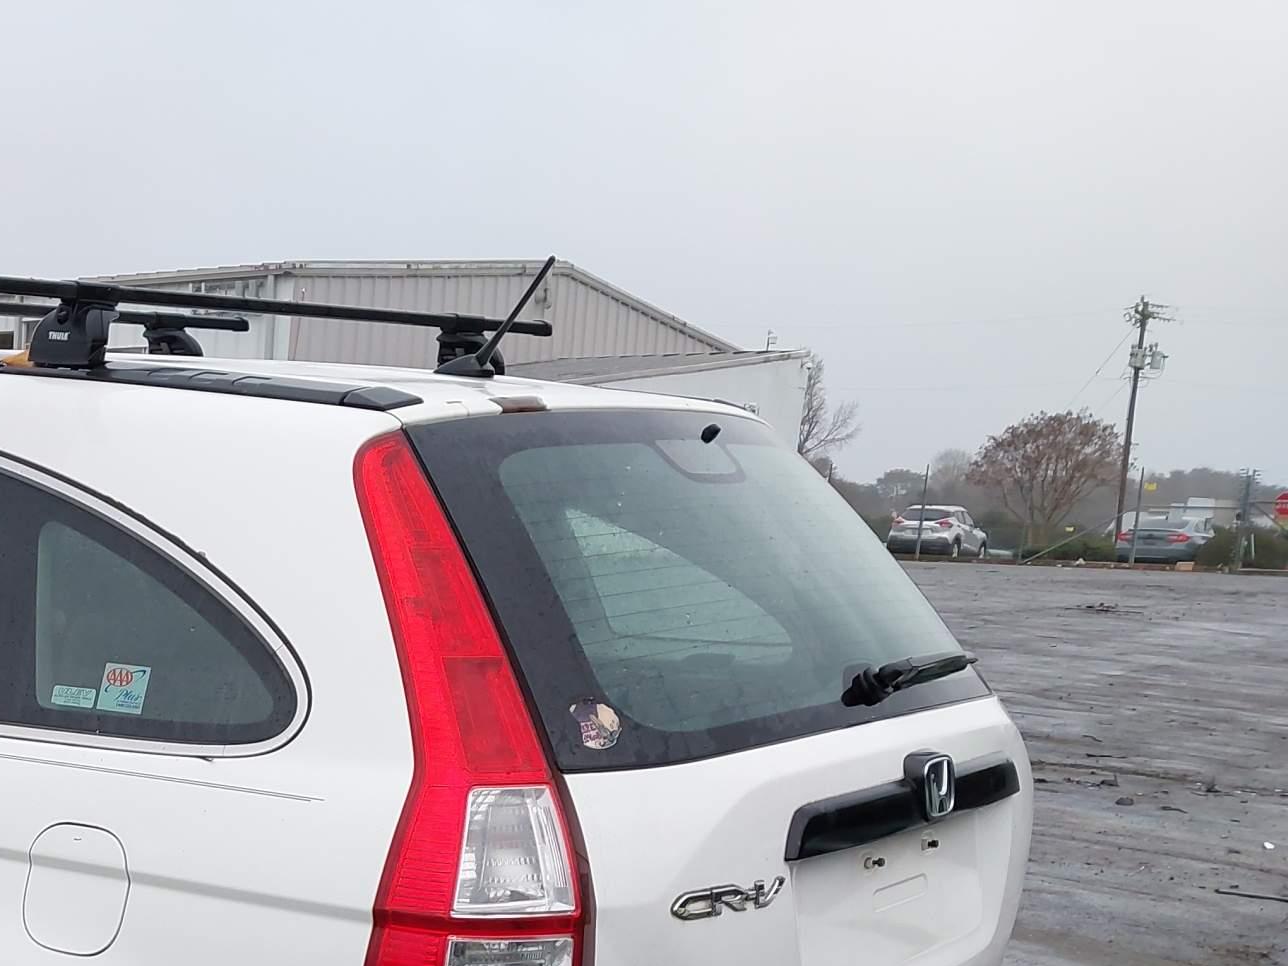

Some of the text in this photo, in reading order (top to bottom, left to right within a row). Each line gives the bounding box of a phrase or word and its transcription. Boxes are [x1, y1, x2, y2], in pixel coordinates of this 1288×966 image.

[48, 331, 70, 341] THULE
[108, 668, 132, 686] AAA
[670, 876, 786, 920] CR-V
